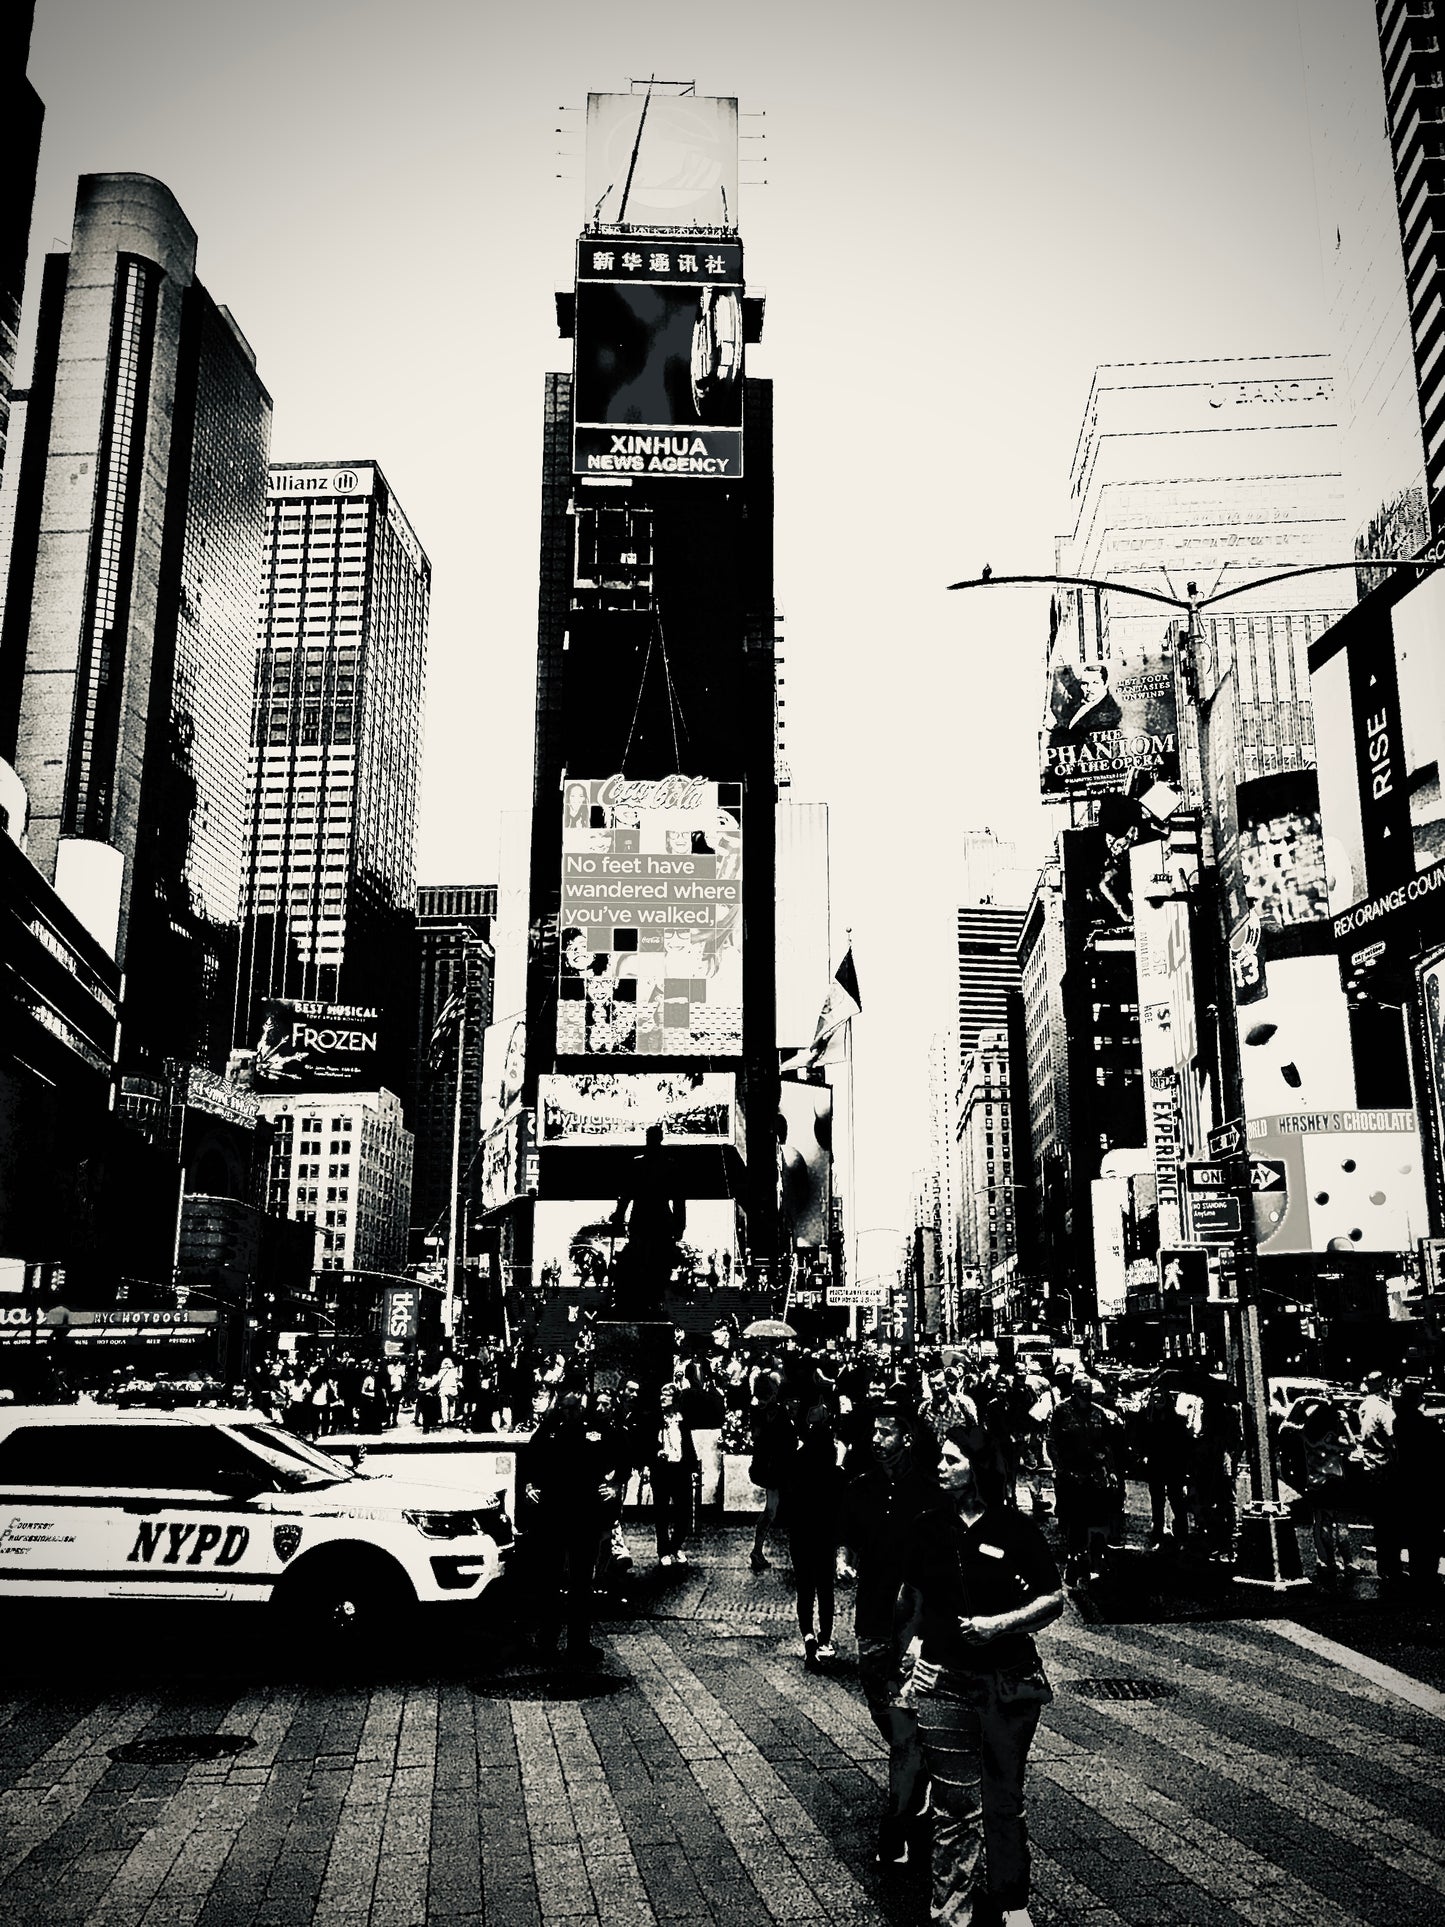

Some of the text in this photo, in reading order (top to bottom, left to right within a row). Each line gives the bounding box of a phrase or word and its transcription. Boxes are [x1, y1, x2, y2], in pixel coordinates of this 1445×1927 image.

[592, 251, 726, 274] 新华通讯社
[610, 435, 708, 456] XINHUA
[587, 455, 730, 473] NEWS AGENCY
[267, 475, 328, 491] Allianz
[1115, 682, 1171, 694] FANTASIES
[1141, 675, 1169, 684] YOUR
[1122, 691, 1165, 701] UNWIND
[1090, 729, 1123, 743] THE
[1045, 733, 1176, 766] PHANTOM
[1367, 707, 1393, 800] RISE
[1054, 754, 1165, 776] OF THE OPERA
[598, 774, 709, 810] Coca-Cola
[566, 856, 695, 875] No feet have
[565, 881, 737, 899] wandered where
[565, 906, 715, 926] you've walked,
[1333, 913, 1356, 938] REX
[1355, 886, 1407, 926] ORANGE
[294, 1003, 378, 1018] BEST MUSICAL
[292, 1023, 377, 1054] FROZEN
[1247, 1112, 1414, 1139] ORLD HERSHEYS CHOCOLATE
[1152, 1101, 1178, 1206] EXPERIENCE
[1252, 1170, 1271, 1184] AY
[94, 1312, 116, 1324] NYC
[391, 1292, 414, 1338] tkts
[126, 1521, 250, 1566] NYPD
